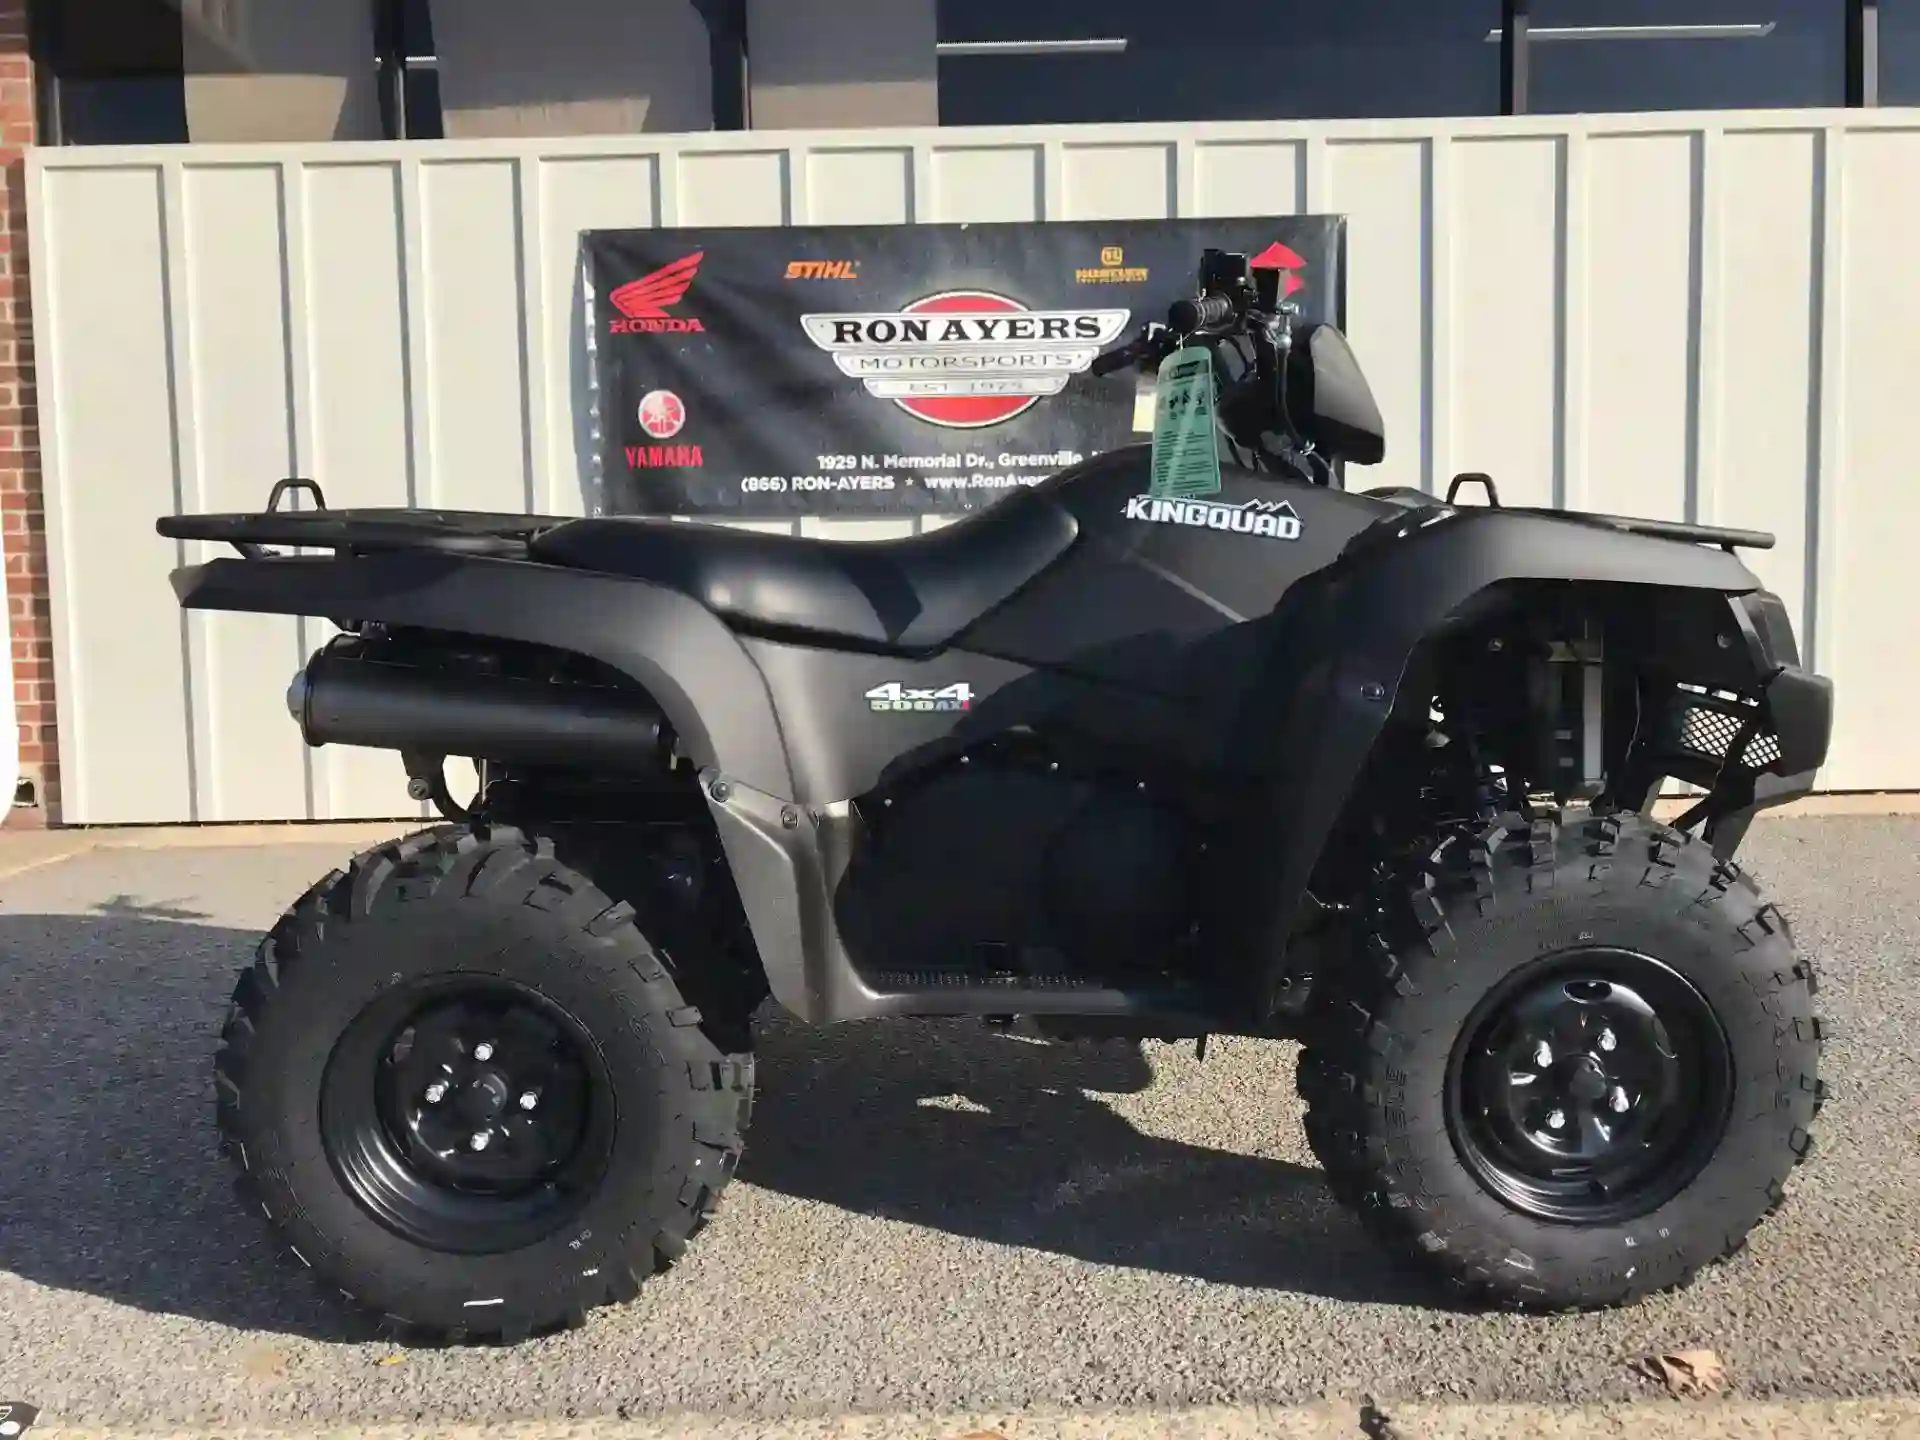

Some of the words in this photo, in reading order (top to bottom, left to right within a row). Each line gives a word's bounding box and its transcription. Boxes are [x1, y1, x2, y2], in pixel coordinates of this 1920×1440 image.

[784, 261, 858, 279] STIHL
[609, 318, 705, 333] HONDA
[831, 319, 931, 343] RON
[938, 316, 1101, 342] AYERS
[860, 354, 1073, 370] MOTORSPORTS
[625, 446, 703, 471] YAMAHA
[817, 455, 857, 470] 1929
[861, 454, 880, 470] N.
[884, 453, 961, 469] Memorial
[998, 450, 1084, 467] Greenville
[740, 476, 788, 493] (866)
[791, 475, 896, 491] RON-AYERS
[1126, 497, 1301, 540] KINGQUAD
